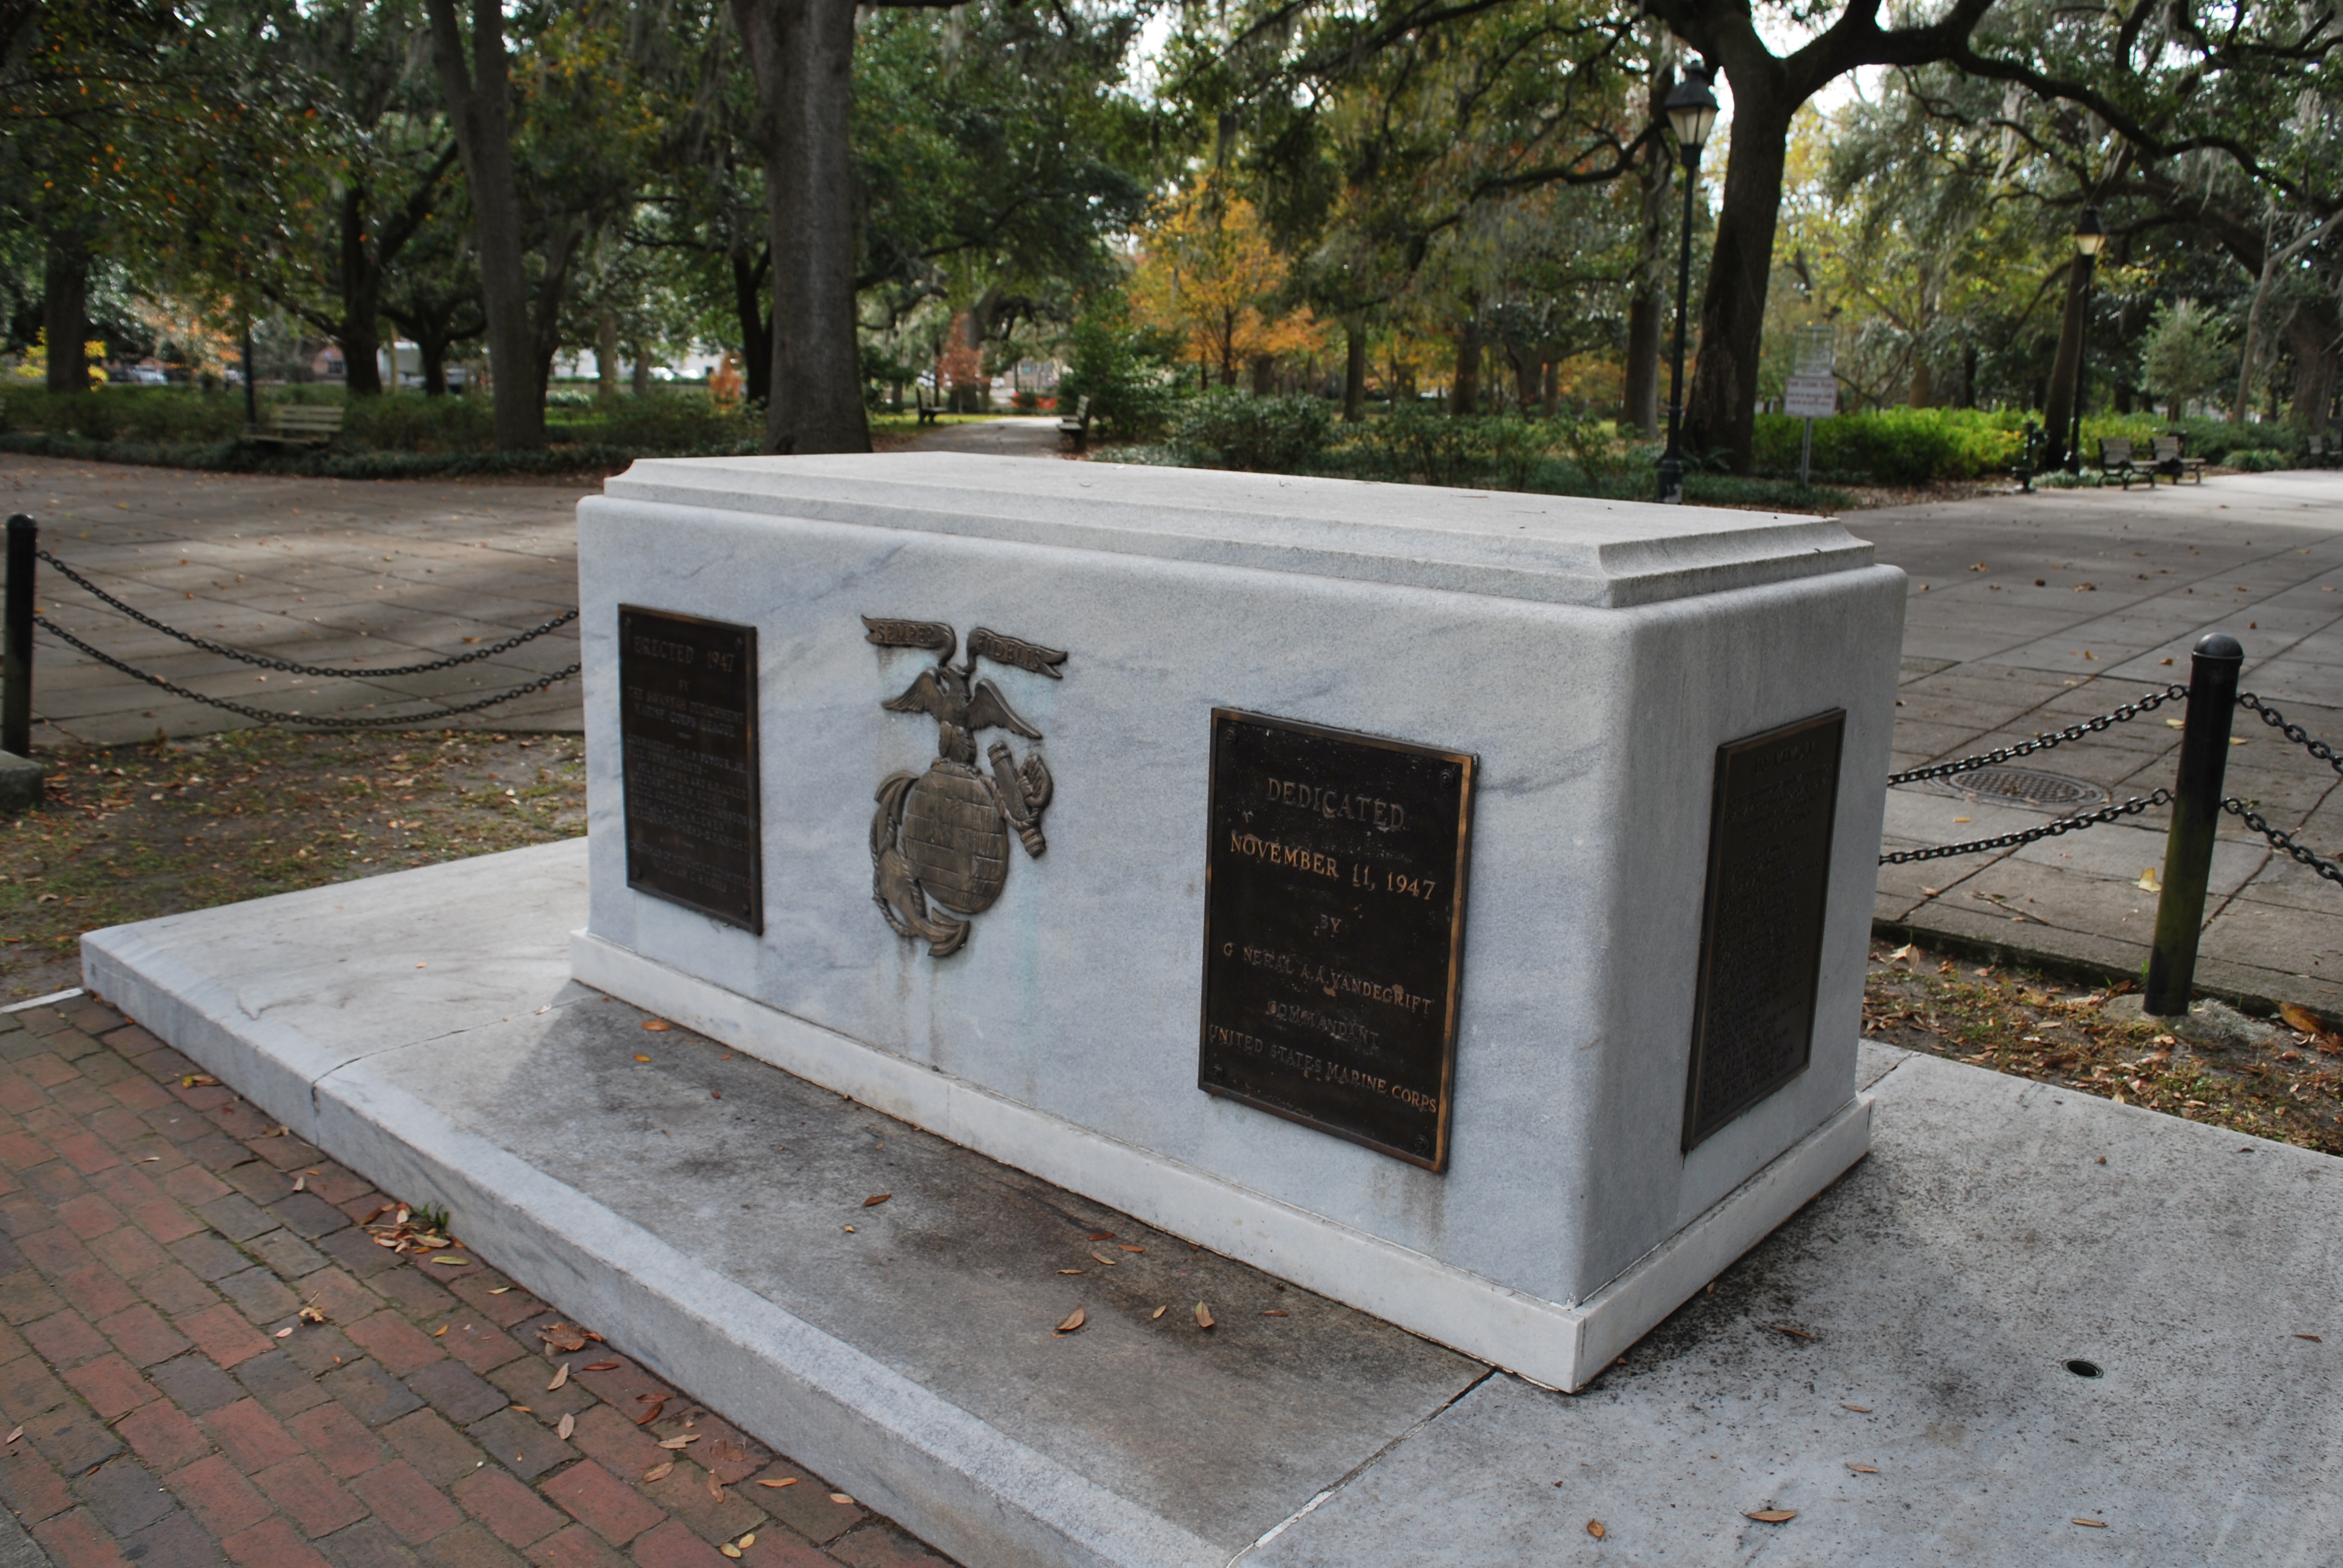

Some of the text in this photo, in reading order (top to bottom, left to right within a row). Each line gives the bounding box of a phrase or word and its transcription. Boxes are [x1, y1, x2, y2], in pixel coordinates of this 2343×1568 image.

[634, 636, 735, 673] ERECTED 1947
[877, 622, 1041, 668] SEMPER FIDELIS
[1267, 777, 1406, 830] DEDICATED
[1230, 833, 1437, 901] NOVEMBER 11, 1947
[1319, 913, 1343, 933] BY
[1223, 942, 1295, 975] GNERAL
[1267, 1000, 1380, 1050] COMMANDANT
[1210, 1024, 1437, 1114] UNITED STATES MARINE CORPS
